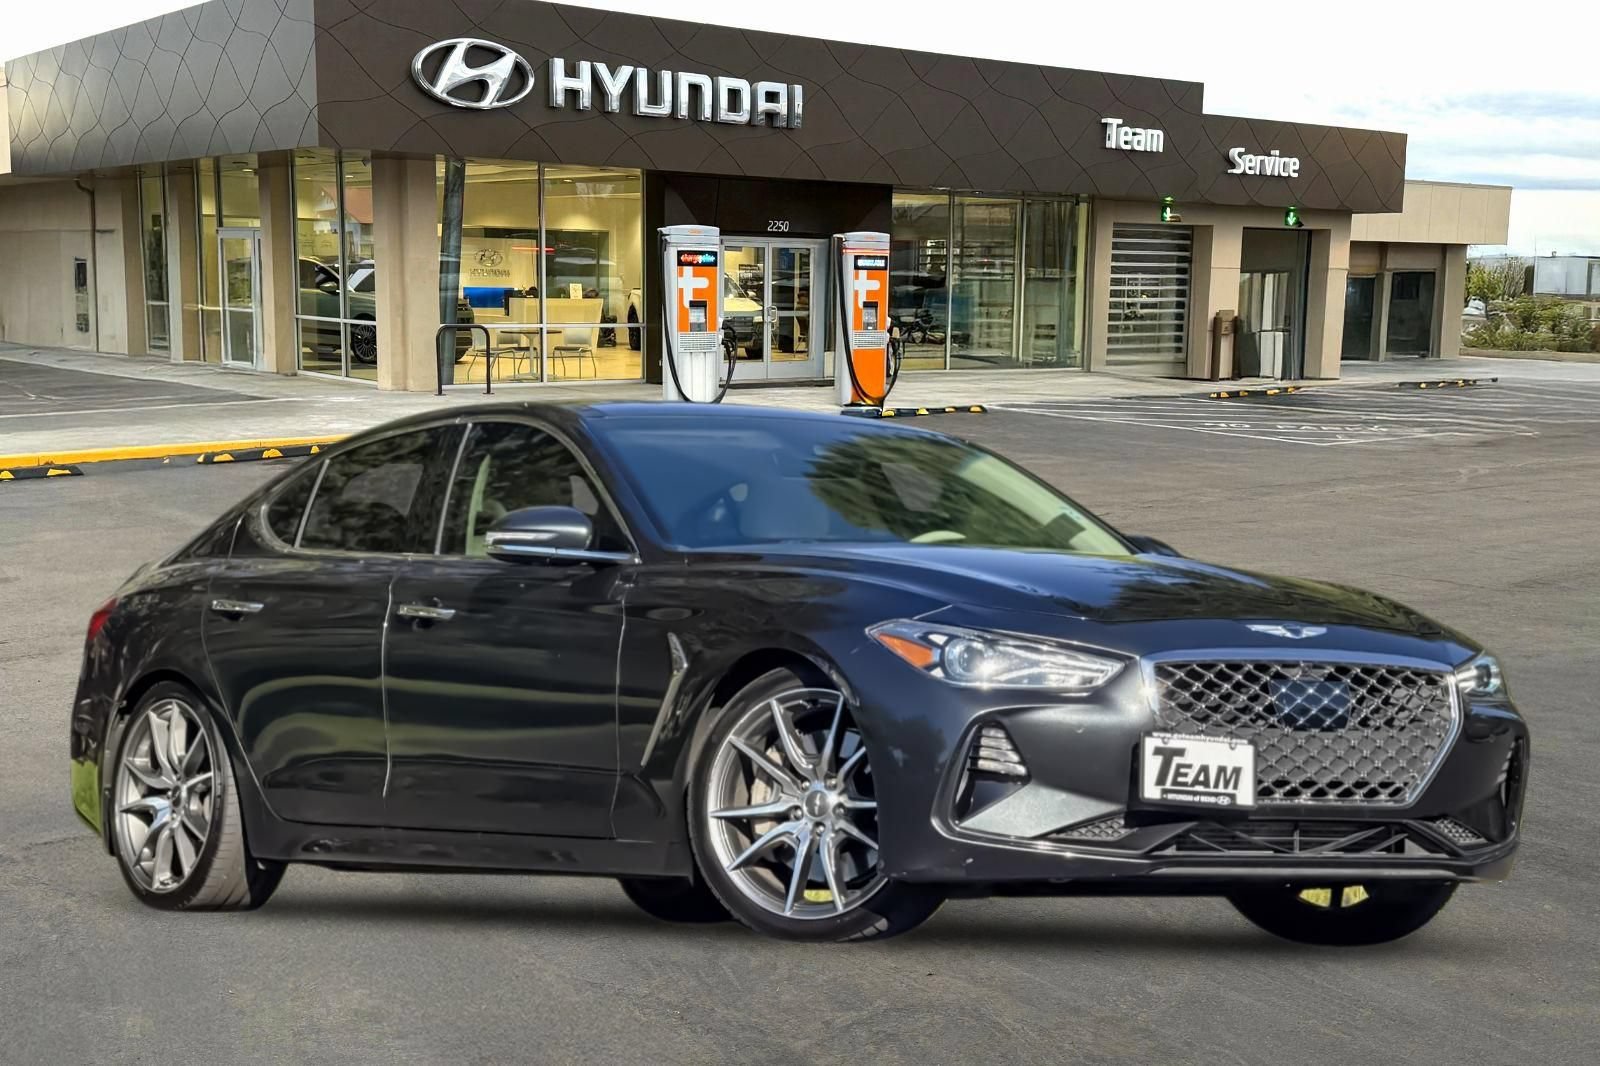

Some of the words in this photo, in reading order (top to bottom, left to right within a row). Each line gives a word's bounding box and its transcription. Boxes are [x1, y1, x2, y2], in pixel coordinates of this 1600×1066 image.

[550, 57, 803, 129] HYUNDAI
[1101, 117, 1164, 152] Team
[1227, 147, 1300, 178] Service
[767, 220, 790, 232] 2250
